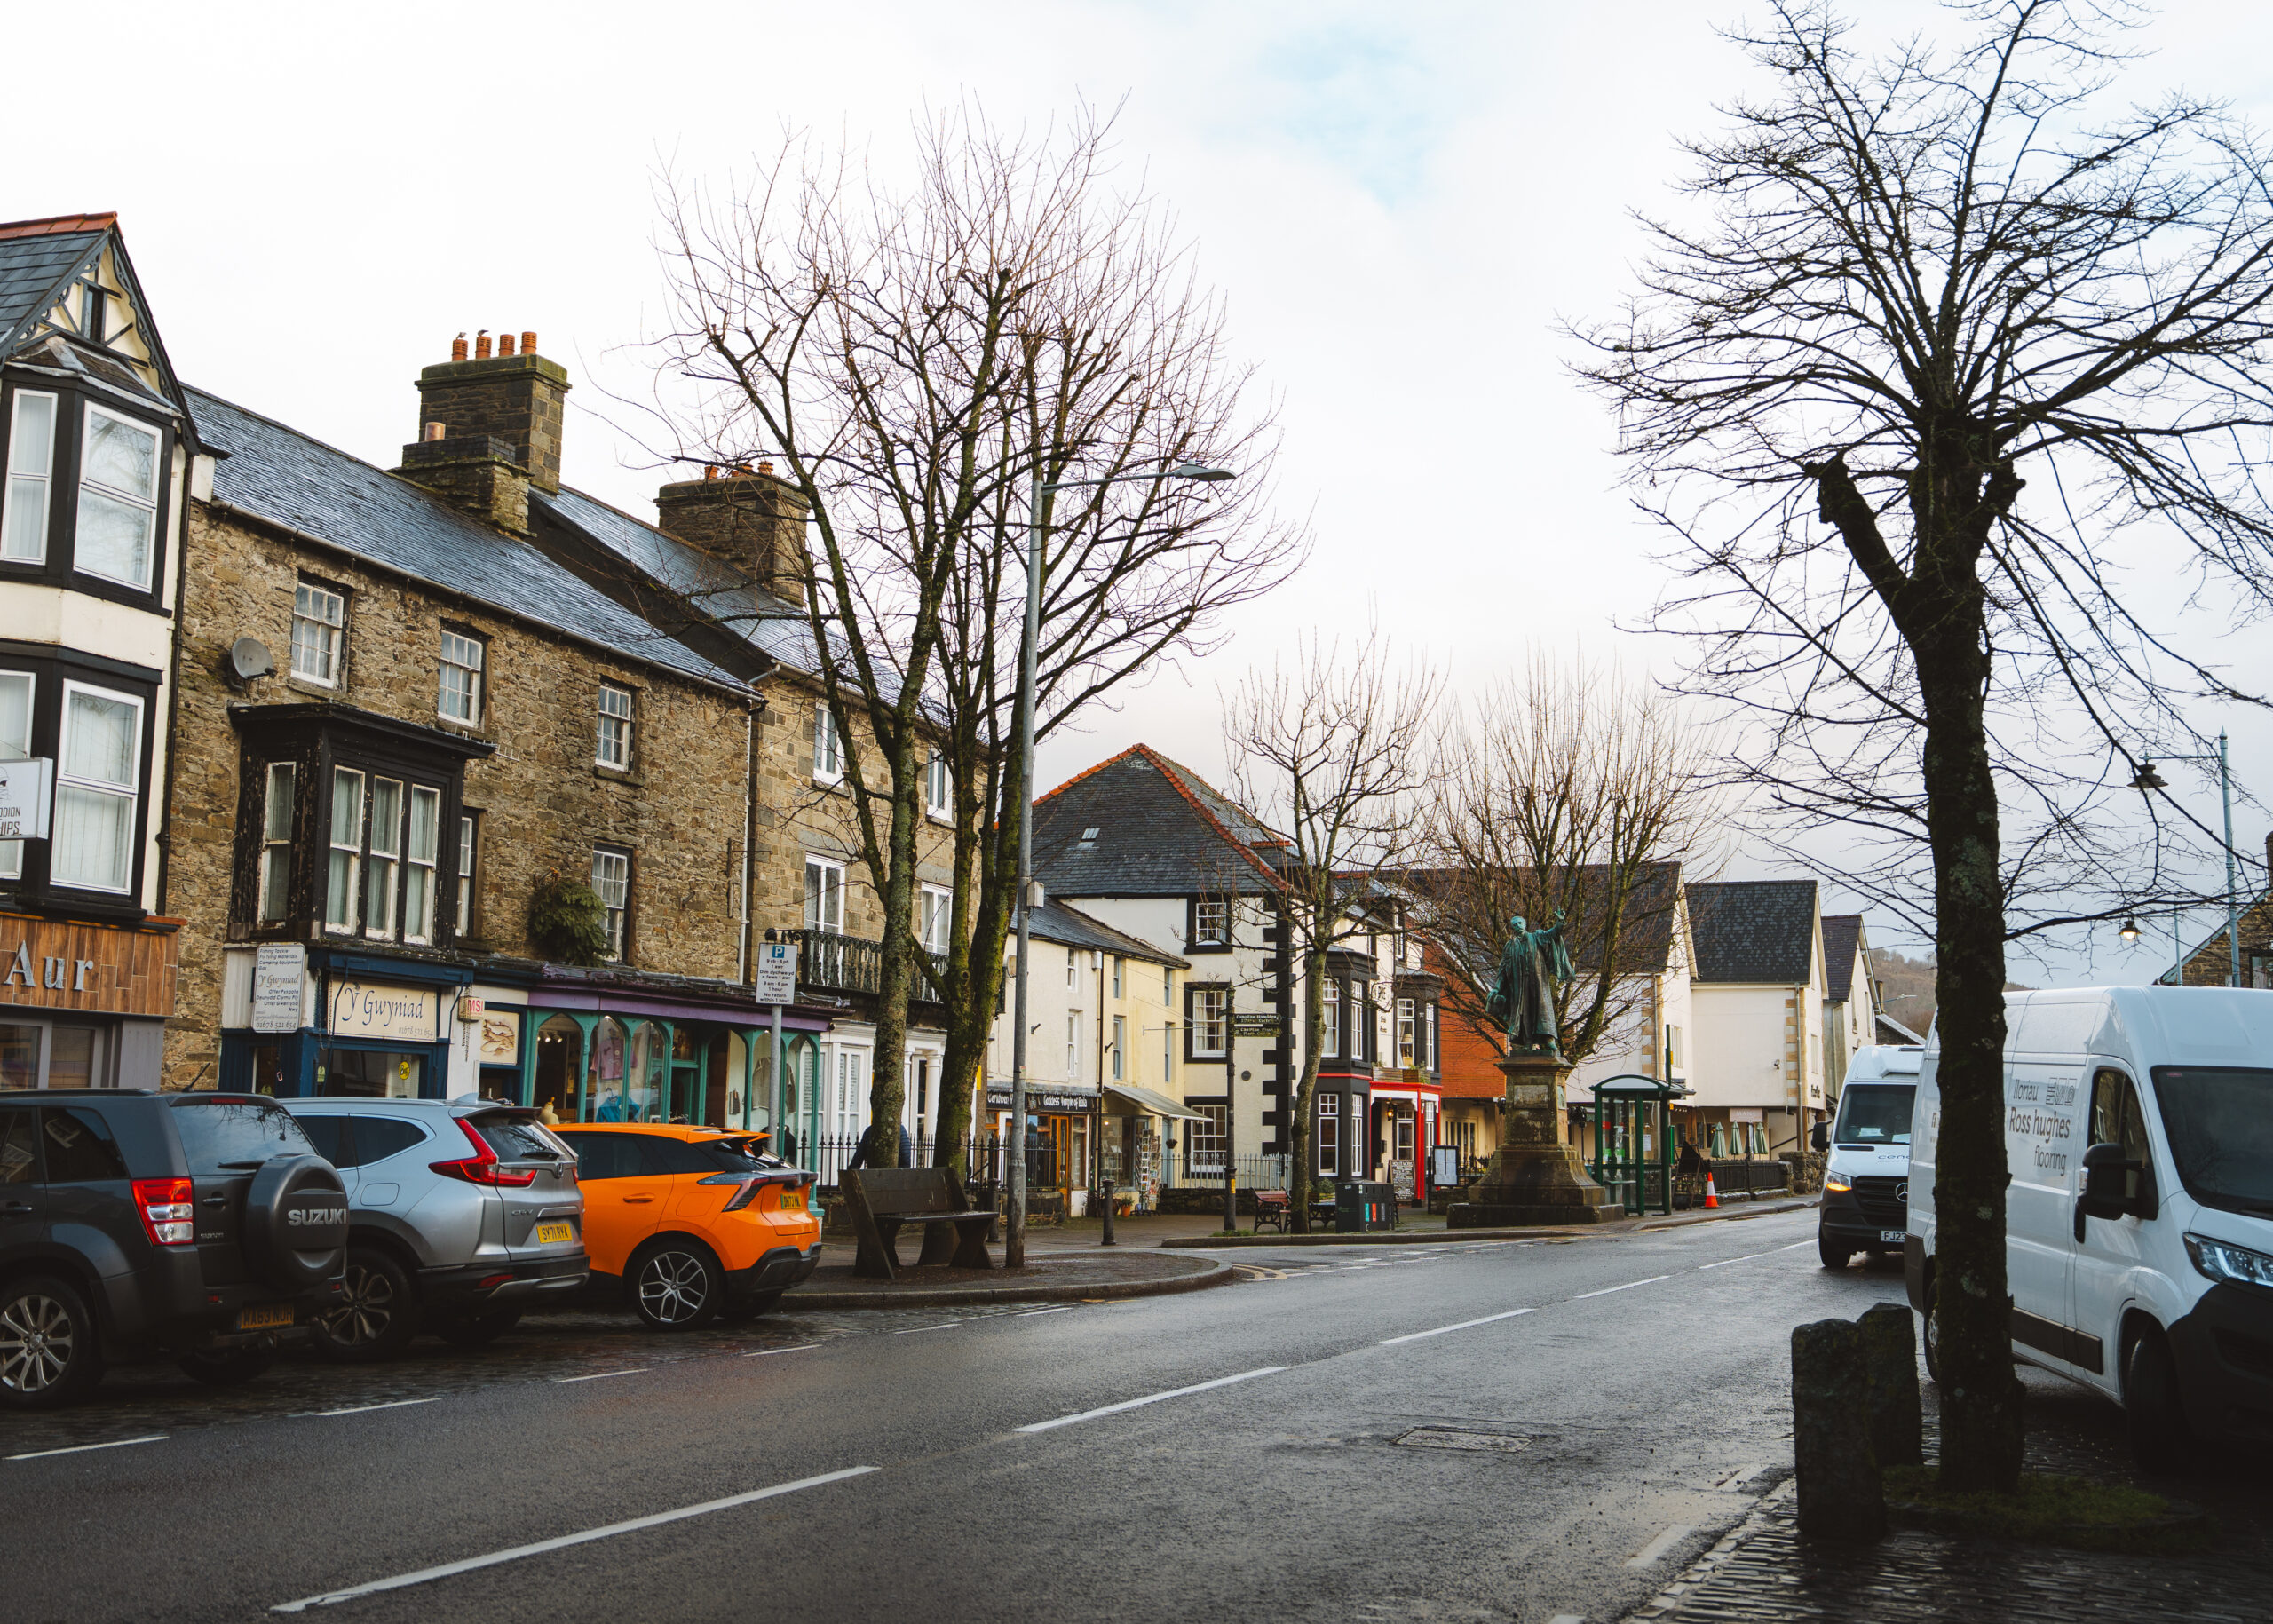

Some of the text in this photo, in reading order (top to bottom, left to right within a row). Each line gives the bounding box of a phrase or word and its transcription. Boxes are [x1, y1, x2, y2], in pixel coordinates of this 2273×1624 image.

[3, 939, 94, 992] Aur
[266, 973, 300, 987] Gwyniad
[342, 987, 426, 1026] Y Gwyniad
[2013, 1079, 2039, 1102] lloriau
[2009, 1106, 2071, 1144] Ross hughes
[2033, 1145, 2067, 1176] flooring
[288, 1208, 347, 1227] SUZUKI
